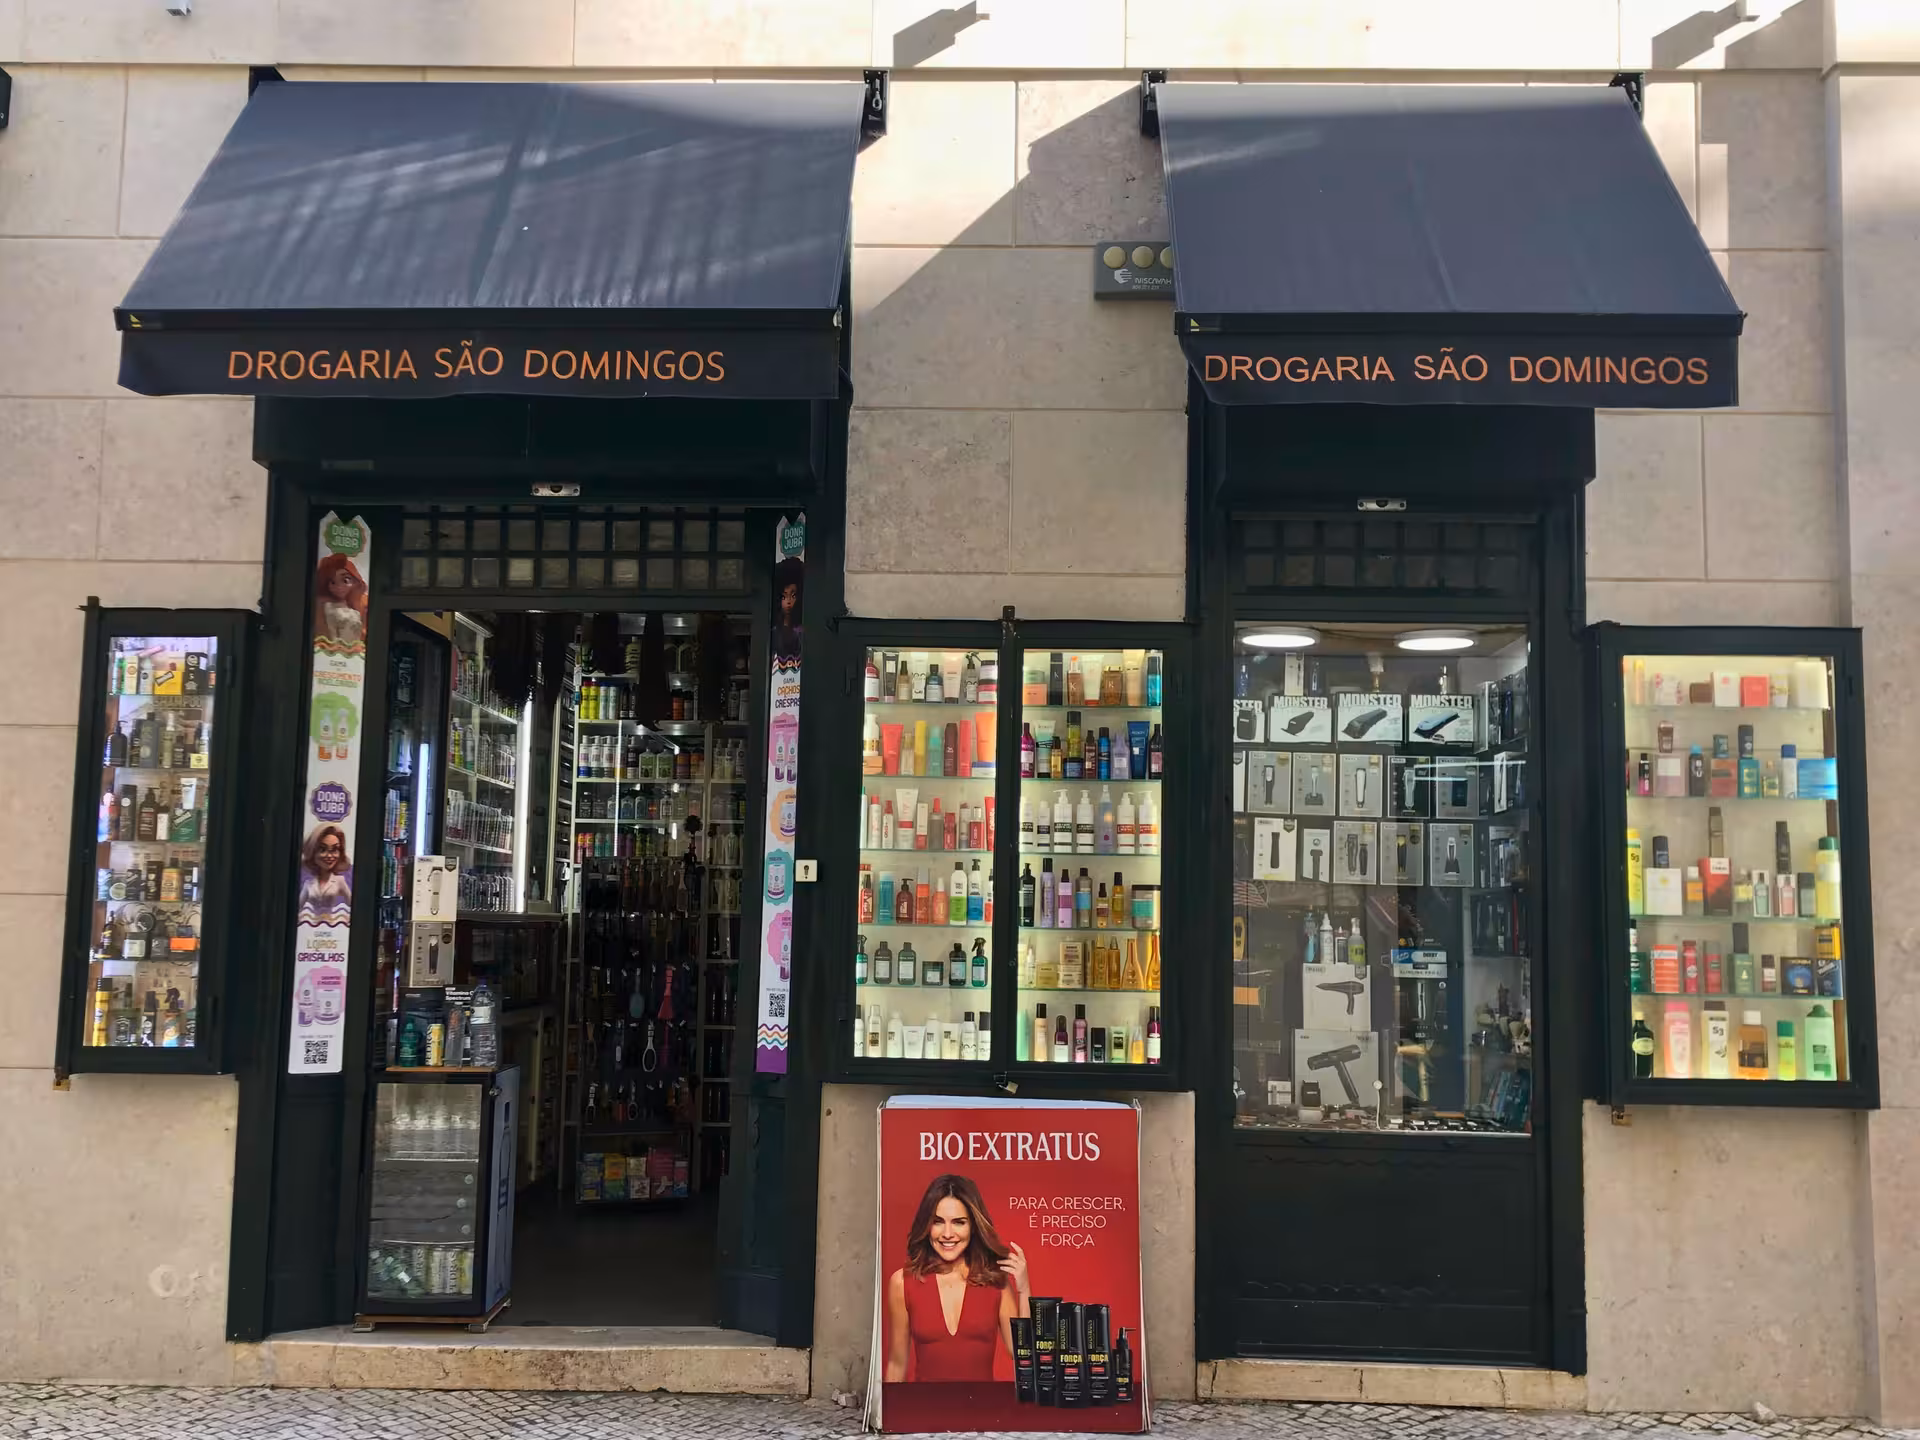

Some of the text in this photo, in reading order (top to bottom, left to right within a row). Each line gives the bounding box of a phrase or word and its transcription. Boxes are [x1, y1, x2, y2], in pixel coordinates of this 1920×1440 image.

[228, 340, 725, 381] DROGARIA SÃO DOMINGOS
[1204, 347, 1709, 385] DROGARIA SÃO DOMINGOS
[332, 524, 360, 537] DONA
[784, 526, 804, 540] DONA
[331, 535, 359, 548] JUBA
[784, 536, 804, 549] JUBA
[777, 685, 800, 696] CACHOS
[1274, 696, 1328, 709] MONSTER
[1339, 693, 1401, 707] MONSTER
[1411, 694, 1473, 708] MONSTER
[317, 790, 346, 803] DONA
[316, 801, 345, 814] JUBA
[297, 952, 345, 962] GRISALHOS
[919, 1132, 1101, 1162] BIO EXTRATUS
[1009, 1197, 1126, 1211] PARA CRESCER,
[1029, 1212, 1107, 1228] É PRECISO
[1041, 1233, 1095, 1250] FORÇA
[1060, 1354, 1083, 1364] FORÇA
[1088, 1354, 1109, 1364] FORÇA
